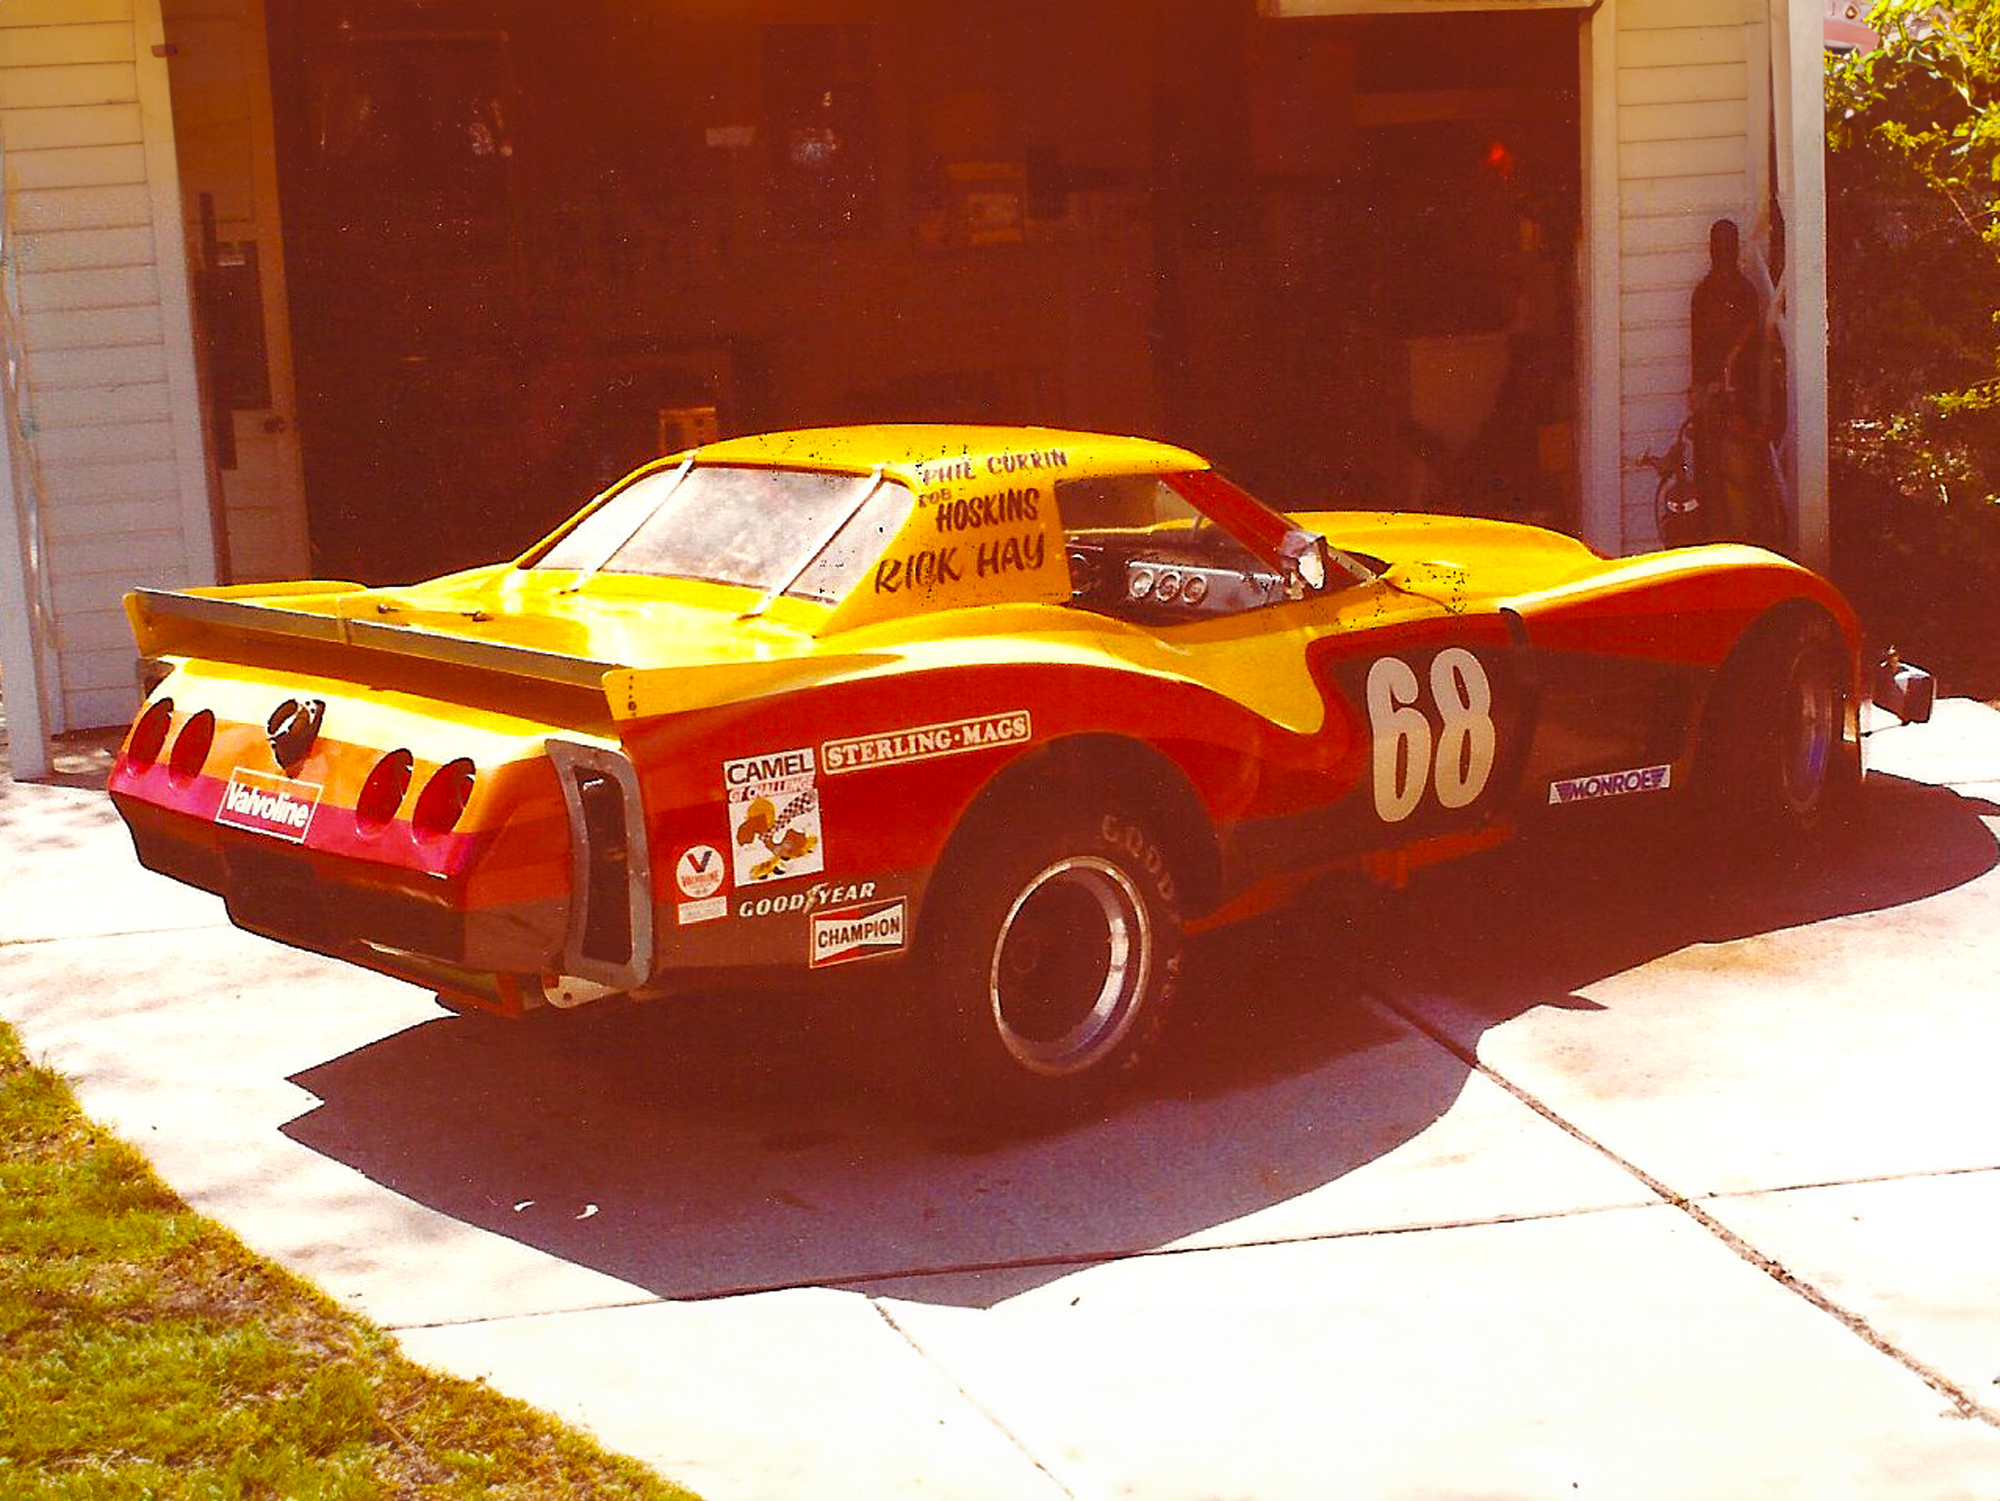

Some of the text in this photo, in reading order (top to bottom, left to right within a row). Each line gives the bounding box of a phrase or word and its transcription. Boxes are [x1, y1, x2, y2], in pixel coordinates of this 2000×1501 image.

[923, 451, 1067, 486] PHIL CURRIN
[936, 488, 1040, 533] HOSKINS
[875, 532, 1044, 594] RICK HAY
[1367, 647, 1496, 823] 68
[727, 754, 814, 785] CAMEL
[1571, 770, 1654, 800] MONROE
[226, 782, 309, 828] Valvoline
[817, 915, 901, 949] CHAMPION
